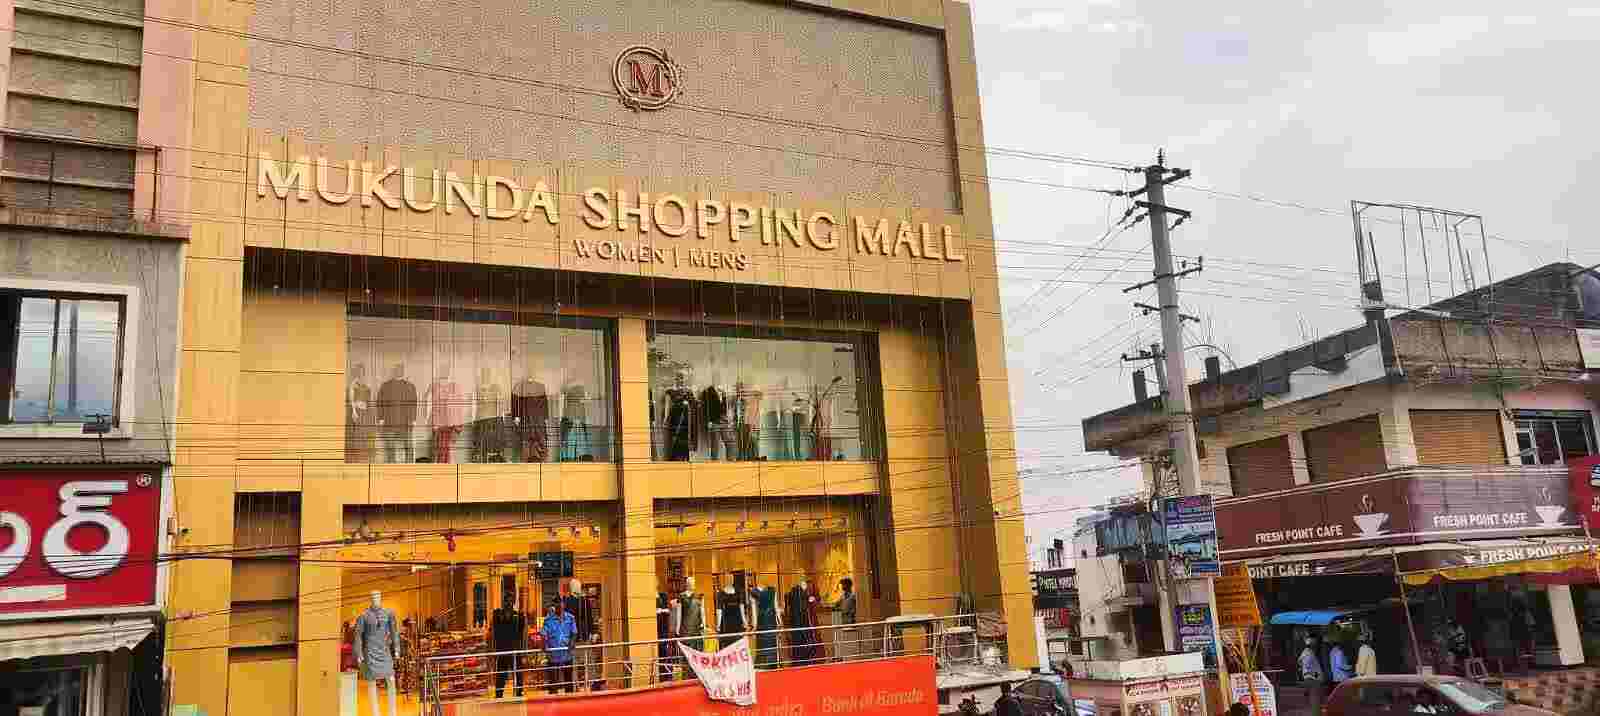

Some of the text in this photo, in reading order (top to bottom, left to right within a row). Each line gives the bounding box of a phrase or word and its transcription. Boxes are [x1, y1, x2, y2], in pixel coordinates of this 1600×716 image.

[627, 61, 666, 97] M
[256, 151, 965, 263] MUKUNDA SHOPPING MALL
[574, 239, 664, 265] WOMEN
[688, 249, 749, 271] MENS
[1433, 512, 1530, 528] FRESH POINT CAFE
[1255, 525, 1344, 545] FRESH POINT CAFE
[1479, 547, 1523, 564] FRESH
[1248, 563, 1312, 578] OINT CAFE
